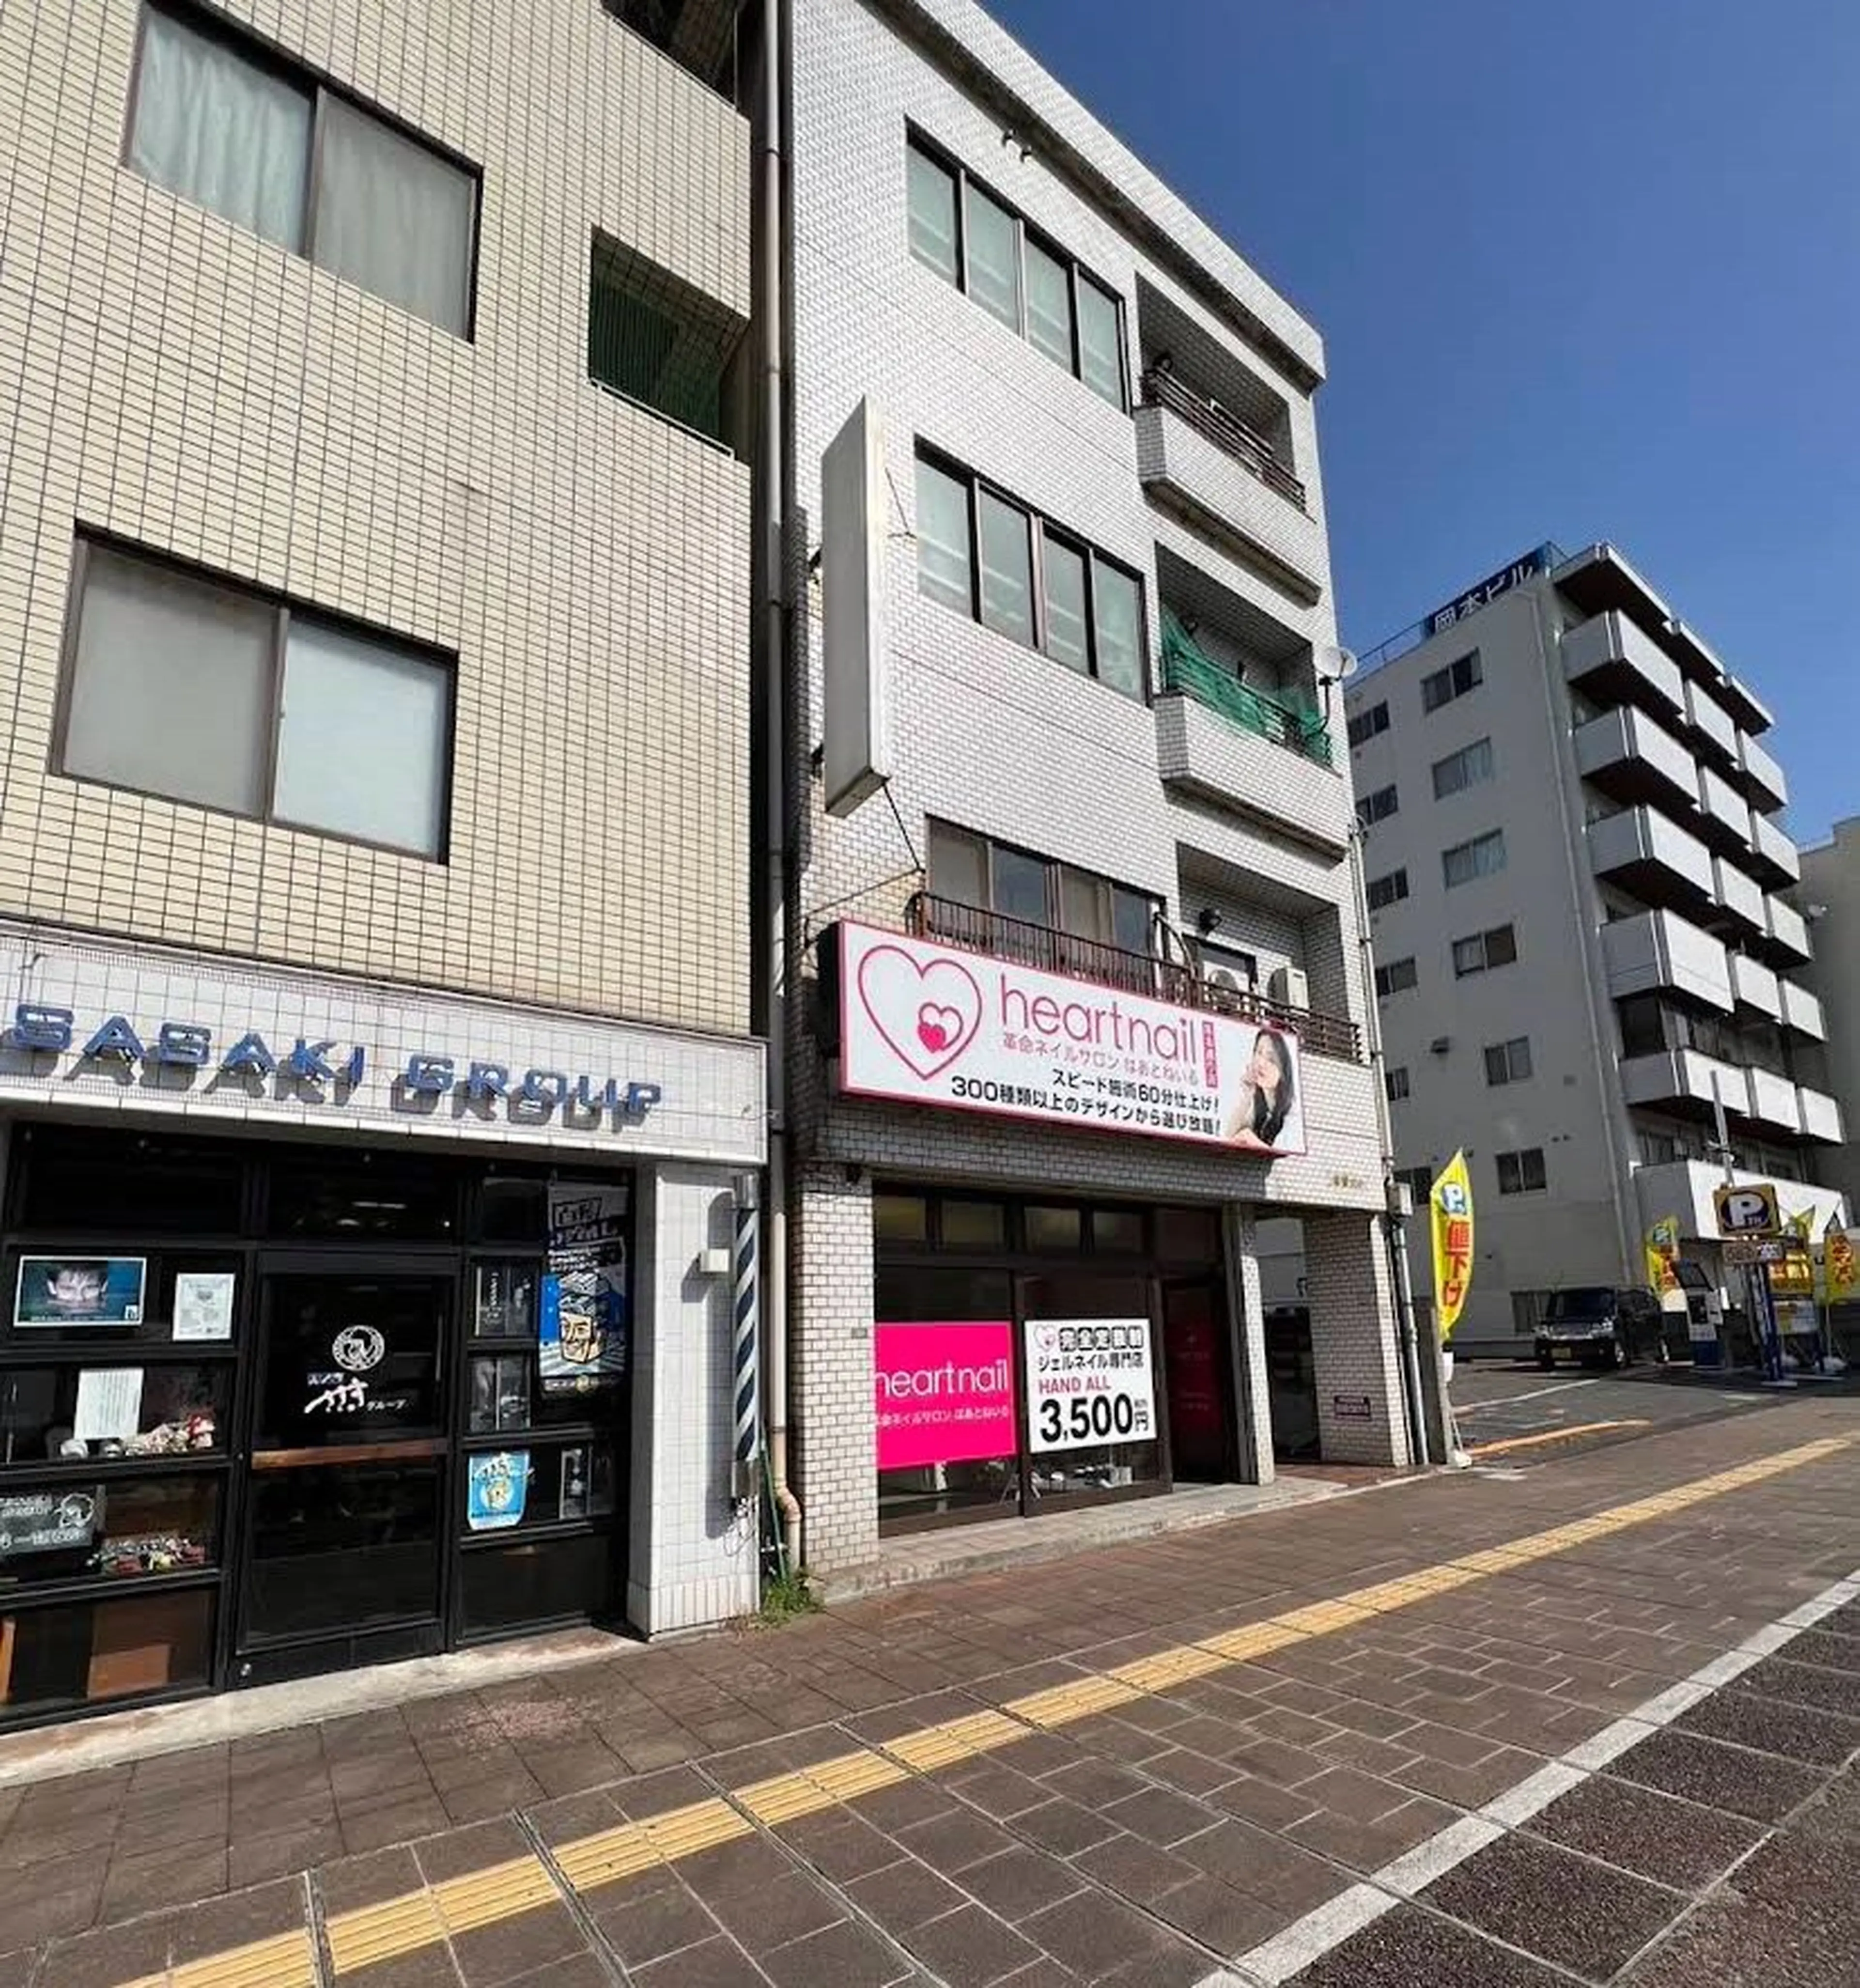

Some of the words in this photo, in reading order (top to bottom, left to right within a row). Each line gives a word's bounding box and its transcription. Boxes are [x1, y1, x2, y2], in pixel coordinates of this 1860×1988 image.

[1435, 565, 1533, 631] 岡本ビル
[14, 1003, 365, 1089] SASAKI
[408, 1054, 662, 1112] GROUP
[1000, 972, 1197, 1064] heartnail
[1038, 1376, 1082, 1394] HAND
[1086, 1375, 1111, 1392] ALL
